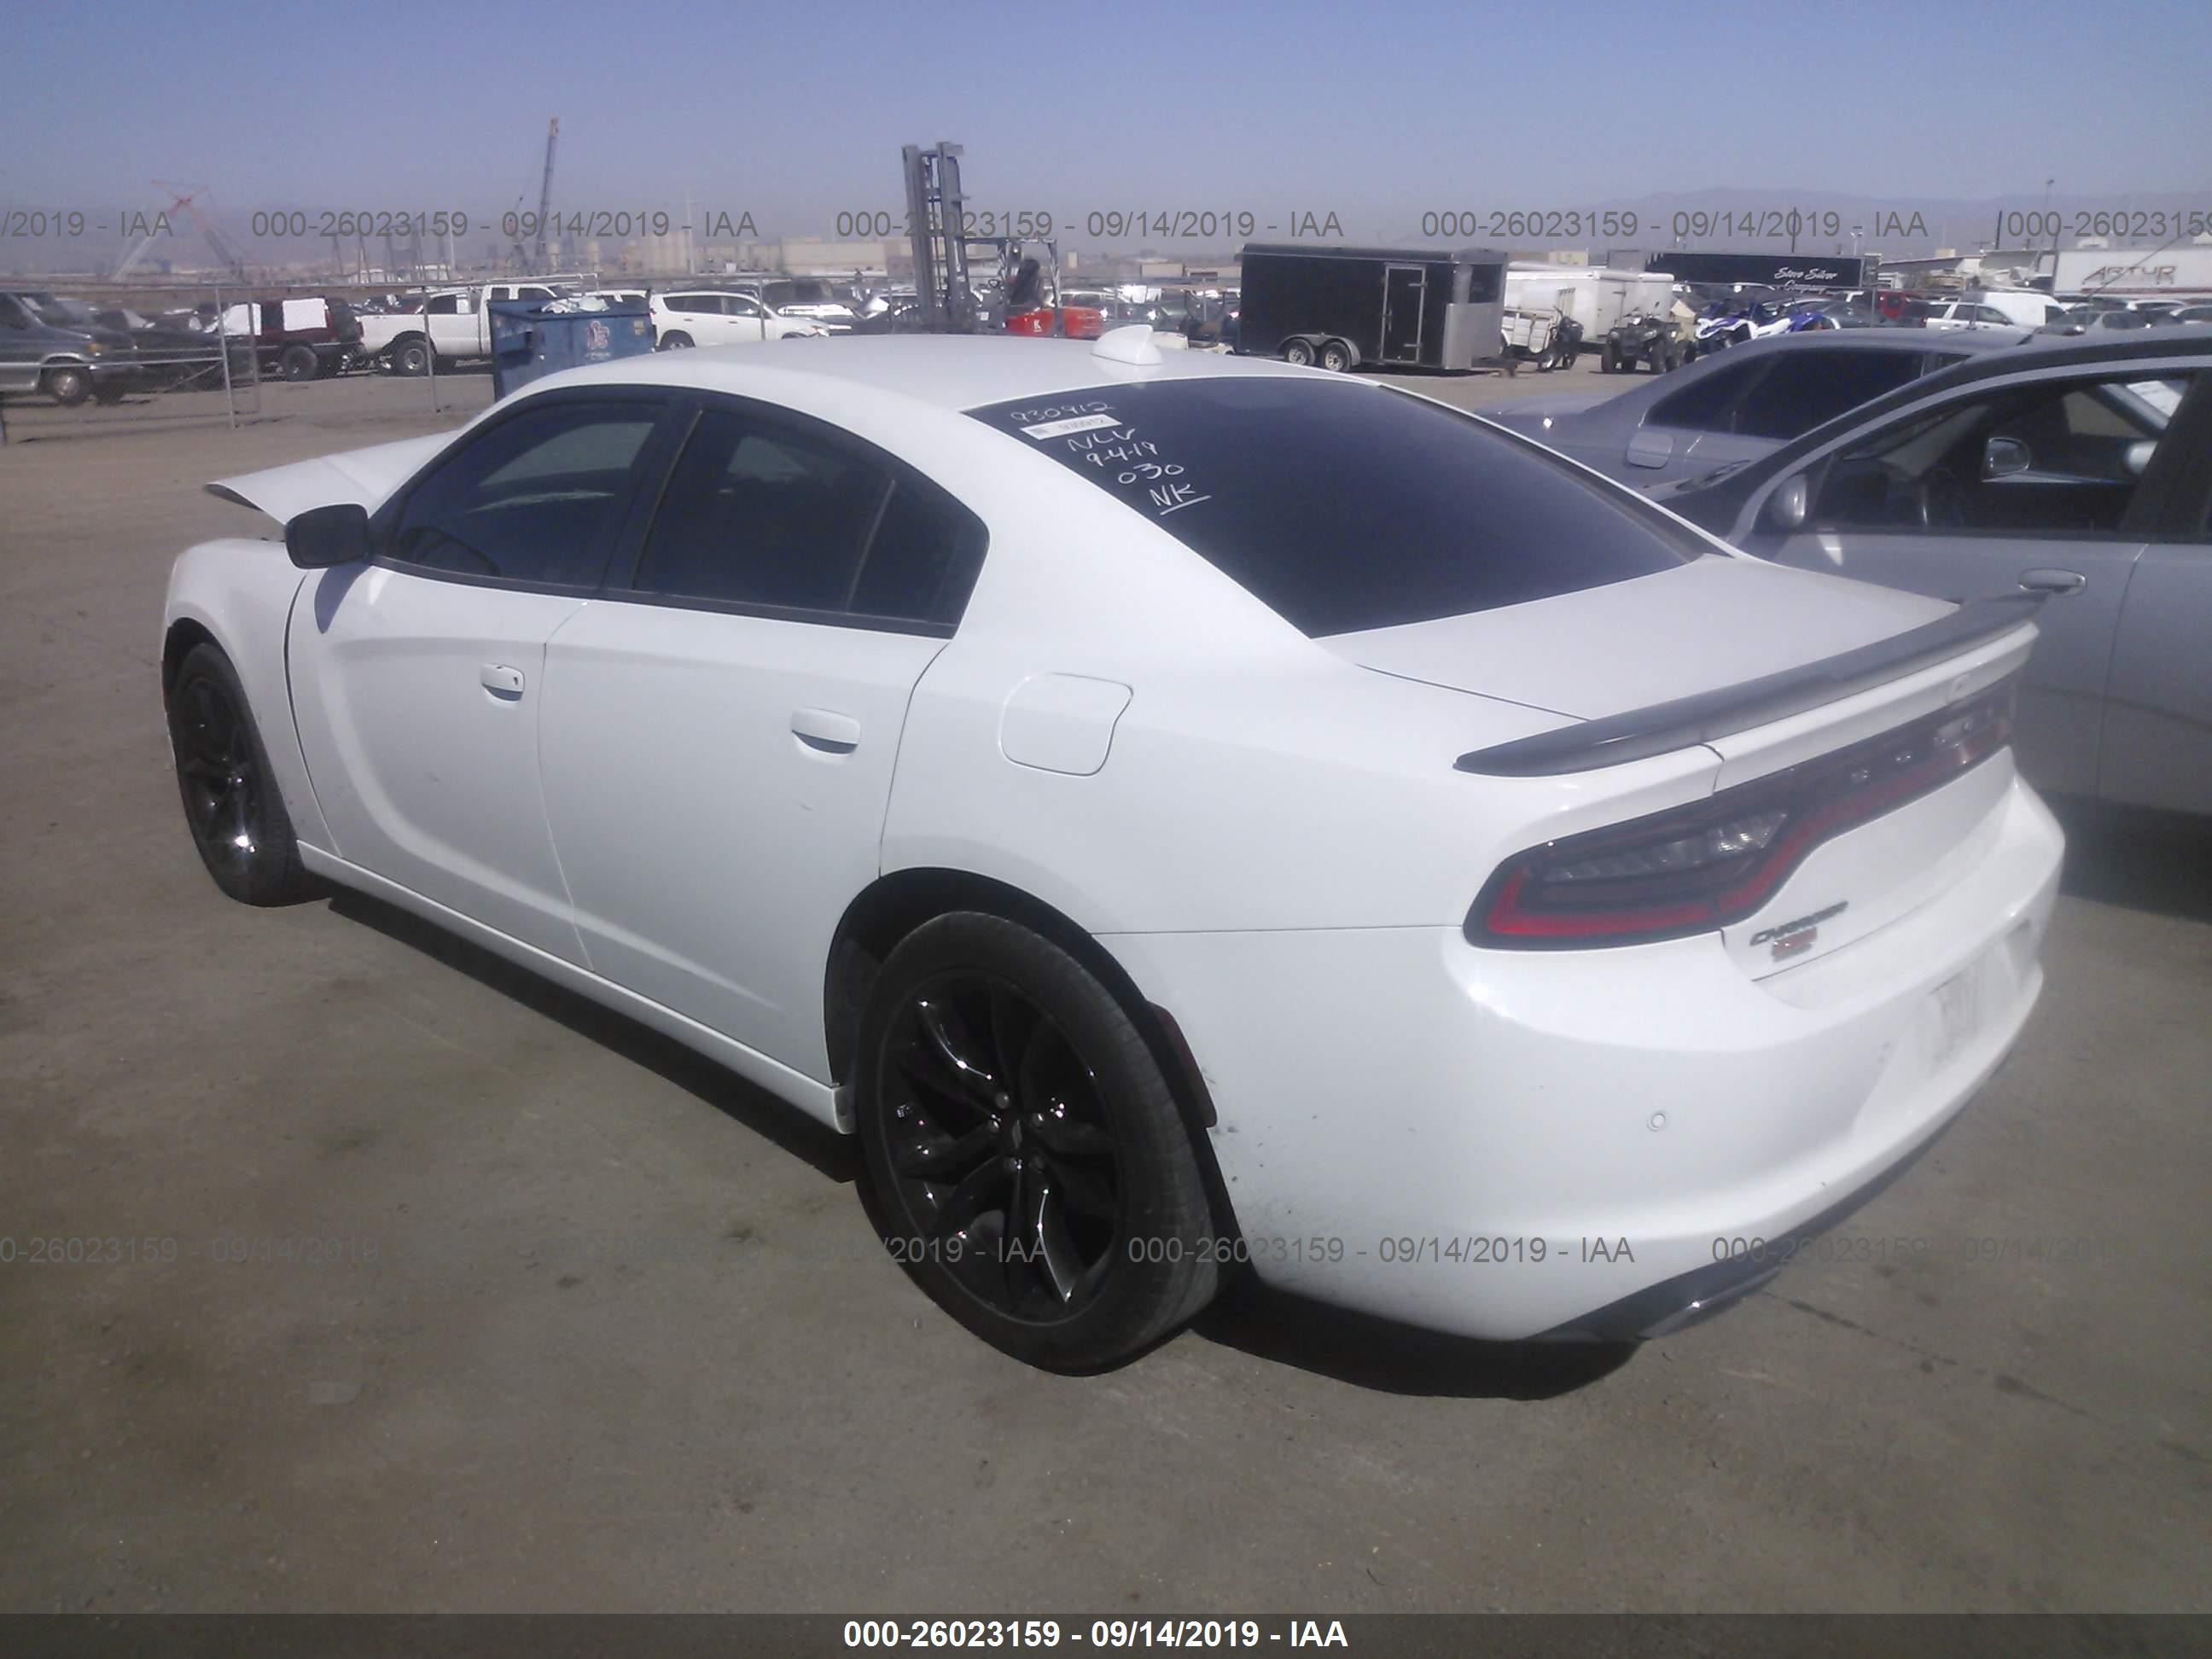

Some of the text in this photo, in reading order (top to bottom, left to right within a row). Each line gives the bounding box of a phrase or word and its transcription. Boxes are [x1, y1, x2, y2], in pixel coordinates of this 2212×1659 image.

[1068, 428, 1136, 451] NLV
[1086, 441, 1158, 467] 9-4-19
[1118, 463, 1185, 484] 030
